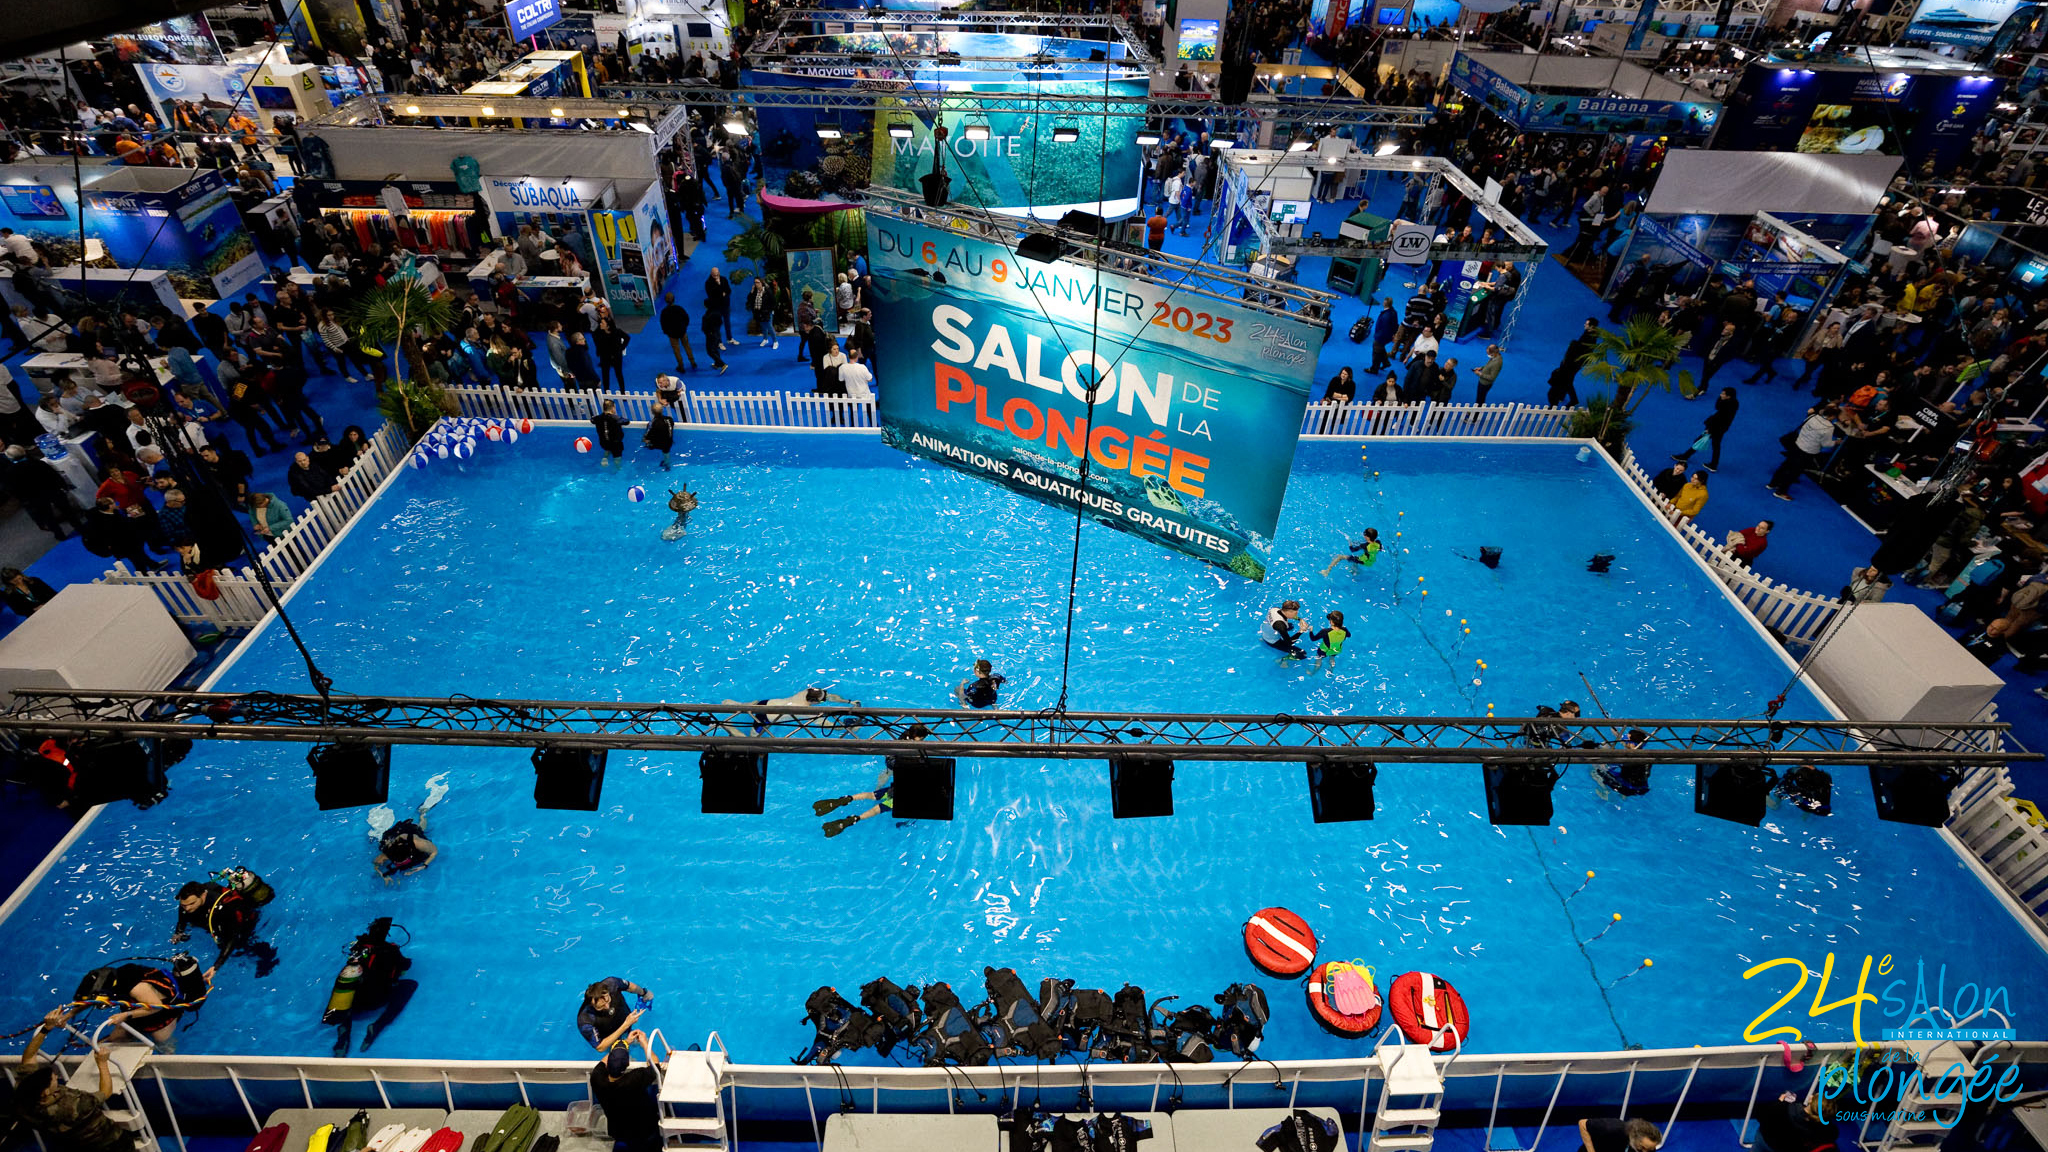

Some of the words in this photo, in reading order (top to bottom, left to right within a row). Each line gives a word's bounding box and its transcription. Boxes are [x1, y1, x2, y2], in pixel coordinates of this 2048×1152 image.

[517, 0, 552, 23] COLTRI
[1909, 28, 1931, 37] EGYPTE
[1935, 31, 1961, 40] SOUDAN
[1495, 78, 1521, 101] Balaena
[1578, 99, 1649, 112] Balaena
[510, 187, 581, 210] SUBAQUA
[1399, 236, 1425, 249] LW
[611, 290, 650, 302] SUBAQUA
[878, 228, 913, 258] DU
[921, 241, 938, 265] 6
[945, 248, 983, 277] AU
[991, 259, 1008, 283] 9
[1015, 267, 1144, 321] JANVIER
[1152, 301, 1234, 343] 2023
[1250, 323, 1280, 346] 24
[931, 304, 1174, 427] SALON
[1182, 382, 1222, 411] DE
[934, 361, 1210, 499] PLONGÉE
[1177, 412, 1212, 442] LA
[1012, 446, 1109, 484] salon-de-la-plong.com
[911, 432, 1009, 476] ANIMATIONS
[1011, 468, 1123, 516] AQUATIQUES
[1126, 507, 1230, 554] GRATUITES
